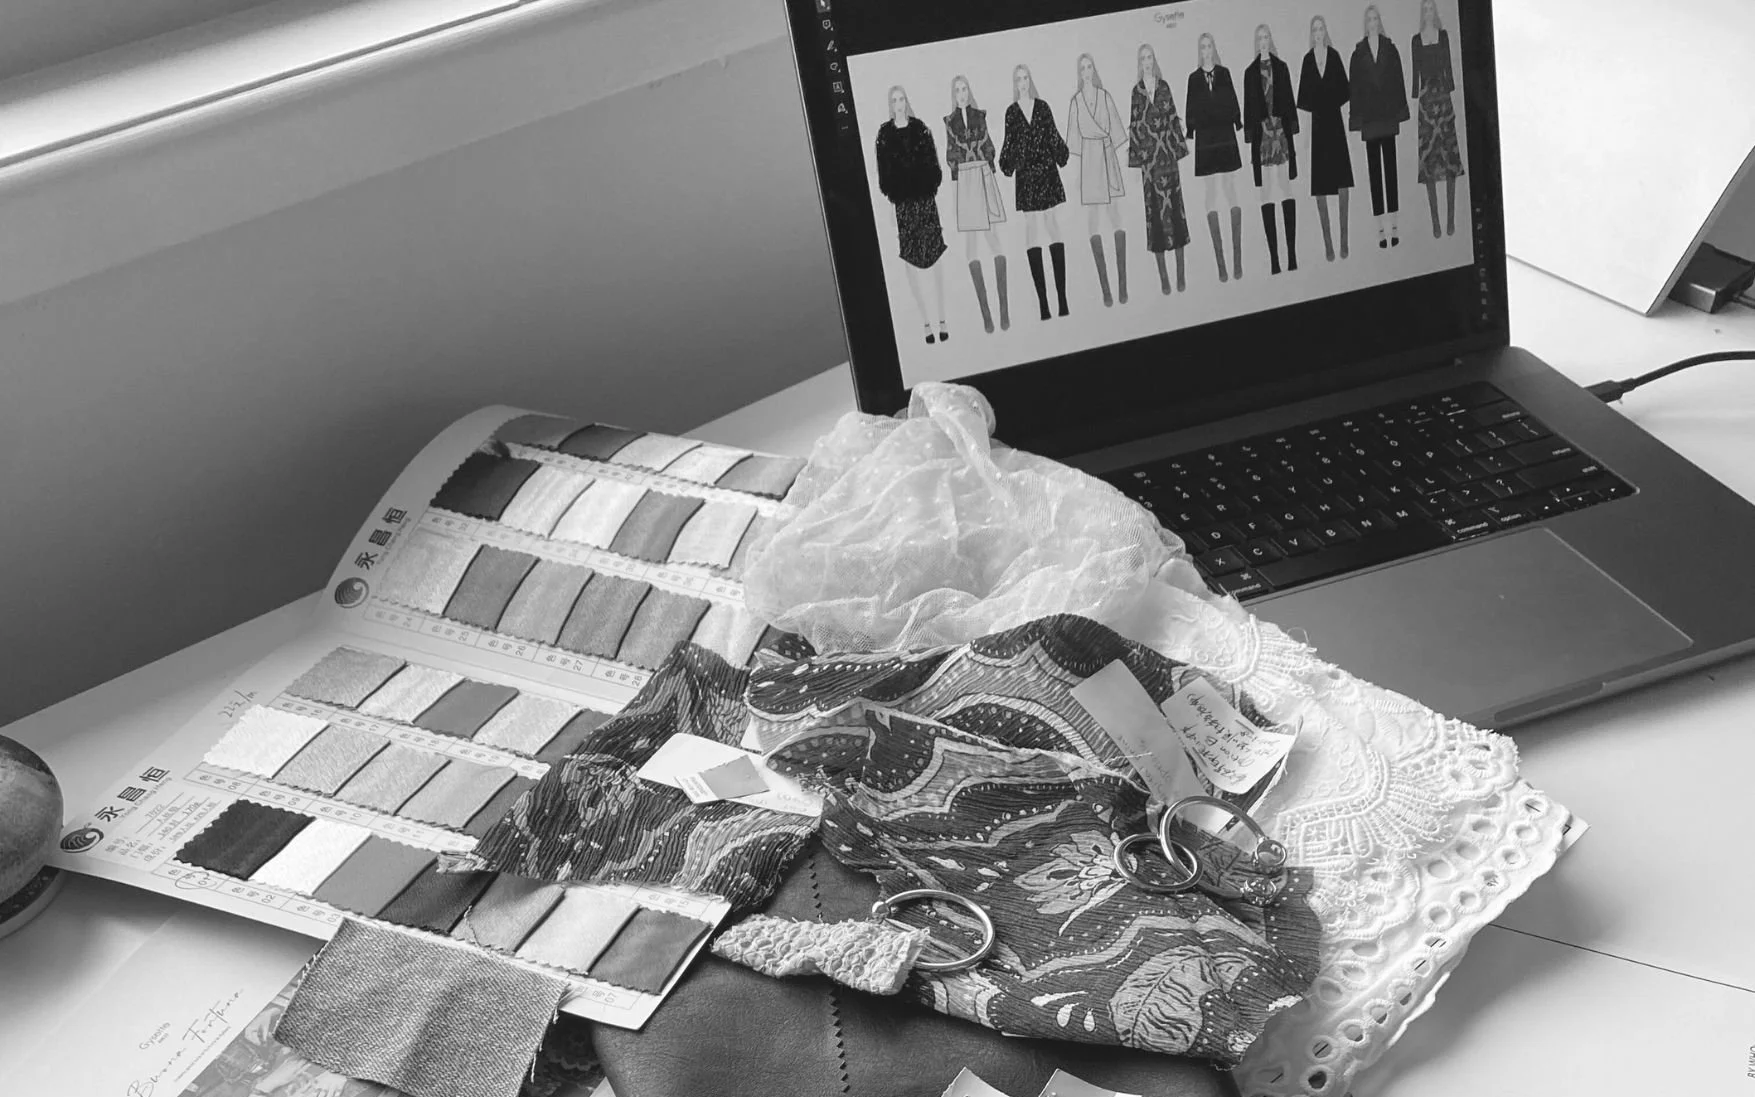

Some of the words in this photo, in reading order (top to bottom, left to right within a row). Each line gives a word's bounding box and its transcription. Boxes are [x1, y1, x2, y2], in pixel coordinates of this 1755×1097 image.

[354, 507, 408, 570] 永昌恒
[94, 766, 170, 822] 永昌恒
